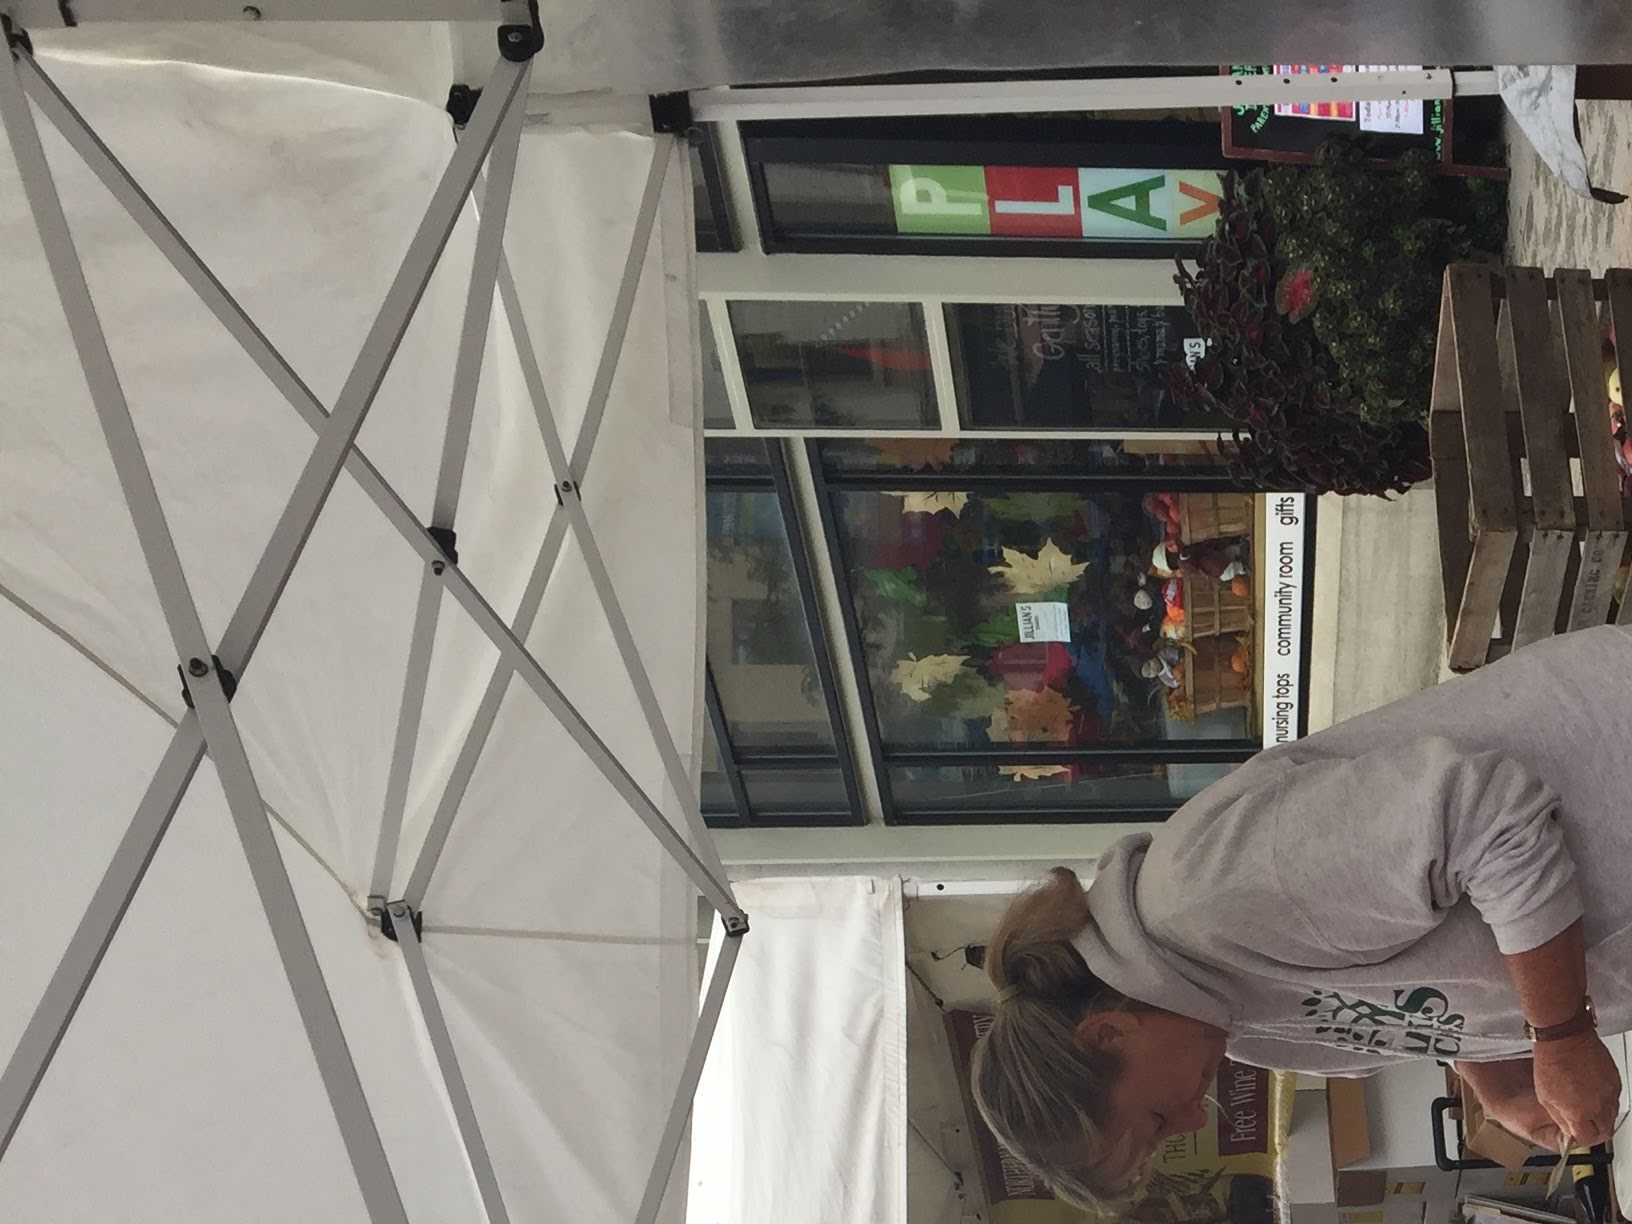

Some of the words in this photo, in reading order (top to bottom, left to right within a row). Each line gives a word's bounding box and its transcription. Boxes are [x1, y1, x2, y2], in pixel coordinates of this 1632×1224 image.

[899, 174, 1222, 232] PLAY
[1274, 496, 1299, 526] gifts
[1276, 541, 1294, 578] room
[1273, 581, 1297, 656] community
[1271, 673, 1294, 698] tops
[1272, 702, 1294, 743] nursing
[1228, 1070, 1257, 1107] Wine
[1230, 1110, 1257, 1142] Free
